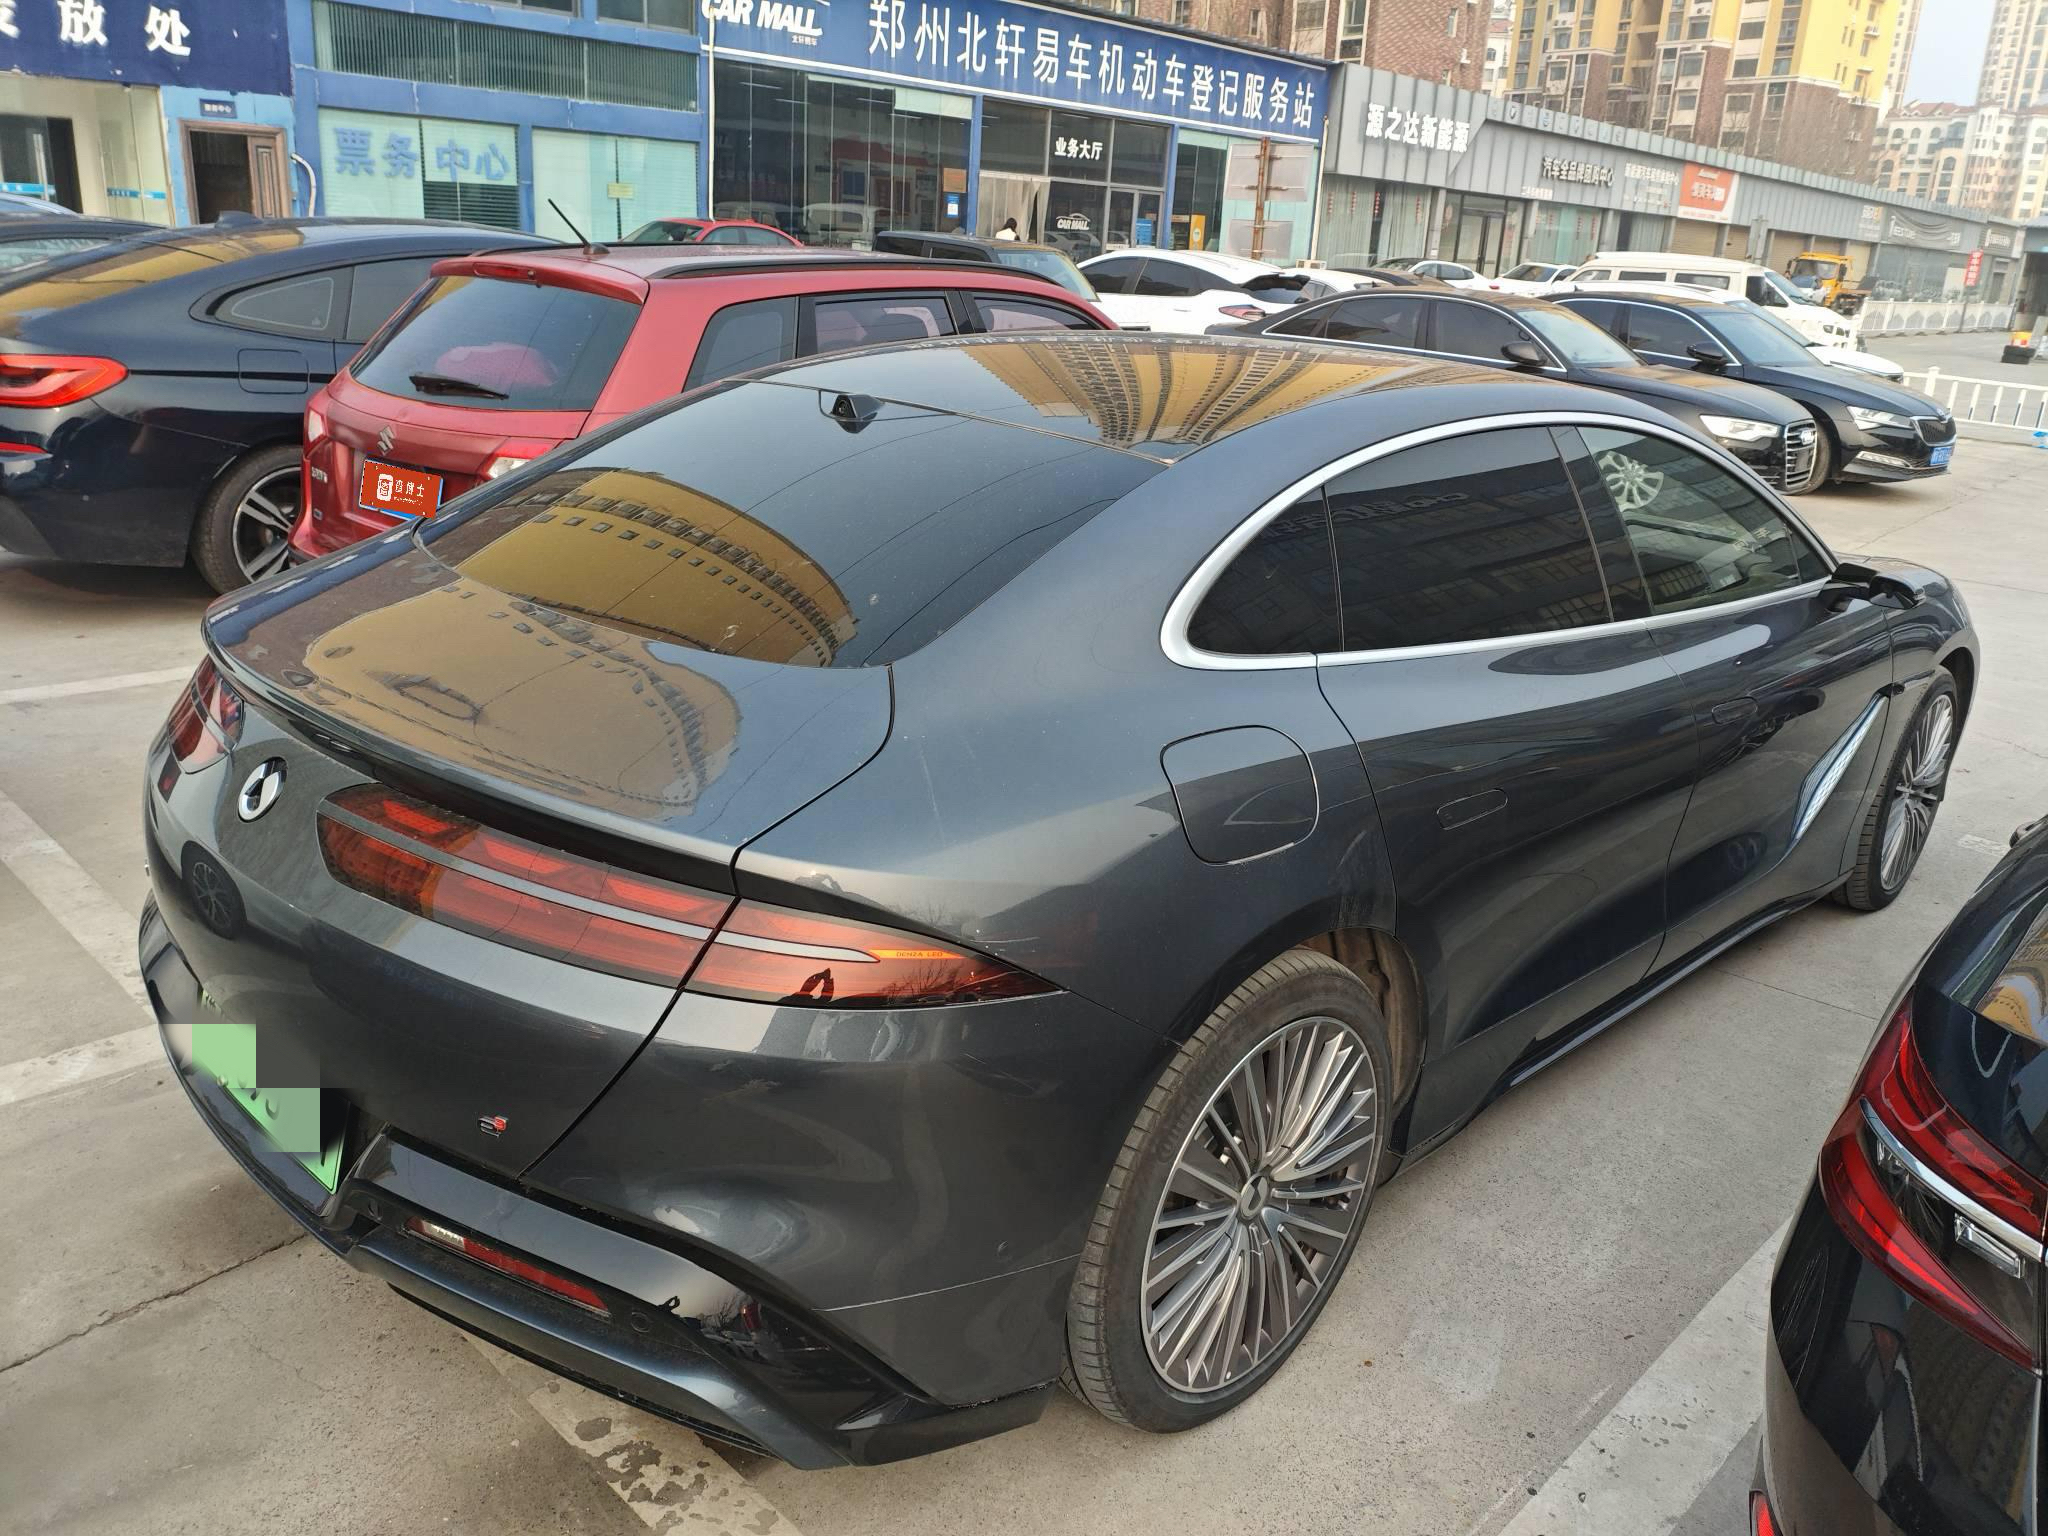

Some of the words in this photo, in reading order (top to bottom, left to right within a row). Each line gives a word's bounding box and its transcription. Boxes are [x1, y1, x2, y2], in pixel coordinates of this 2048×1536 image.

[701, 0, 753, 25] CAR
[756, 0, 823, 36] MALL
[869, 0, 1316, 129] 郑州北轩易车机动车登记服务站
[1054, 137, 1103, 161] 业务大厅
[1365, 102, 1470, 153] 源之达新能源
[335, 127, 512, 182] 票务中心
[1057, 219, 1071, 229] CAR
[1070, 220, 1090, 230] MALL
